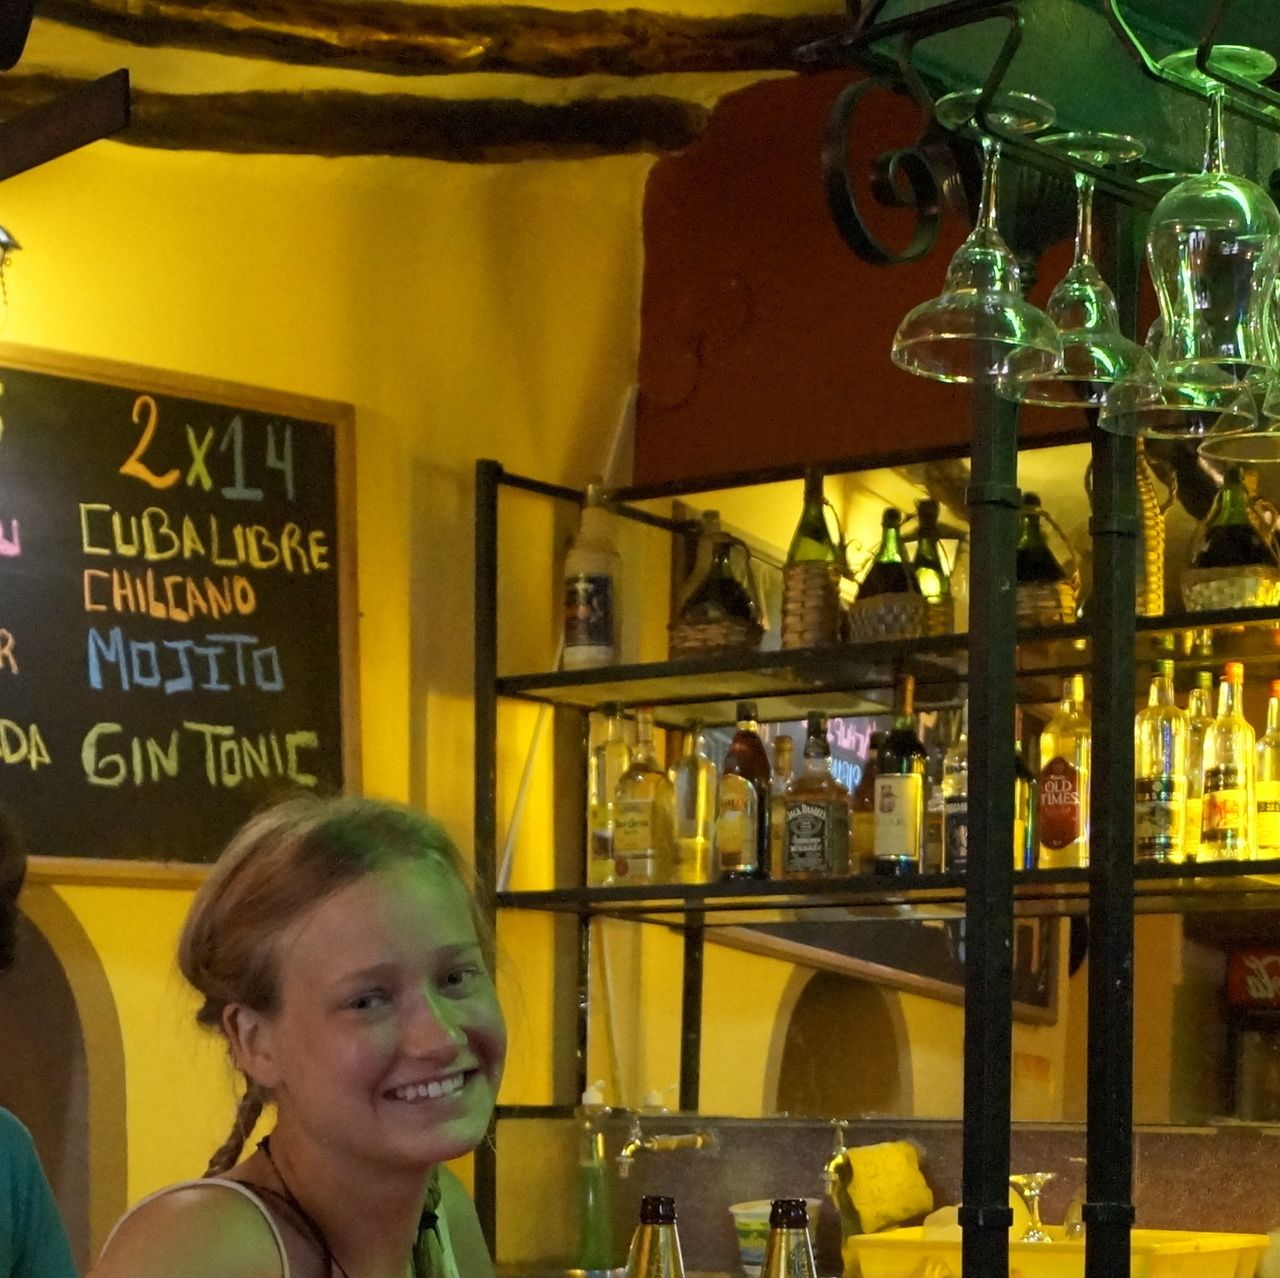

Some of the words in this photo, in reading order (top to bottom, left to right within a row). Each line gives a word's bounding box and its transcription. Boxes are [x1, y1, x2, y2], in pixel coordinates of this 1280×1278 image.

[82, 568, 258, 623] CHILCANO
[86, 626, 284, 694] MOJITO
[81, 720, 179, 787] GIN
[185, 720, 319, 788] TONIC
[1041, 792, 1080, 804] TIMES
[1044, 780, 1072, 792] OLD
